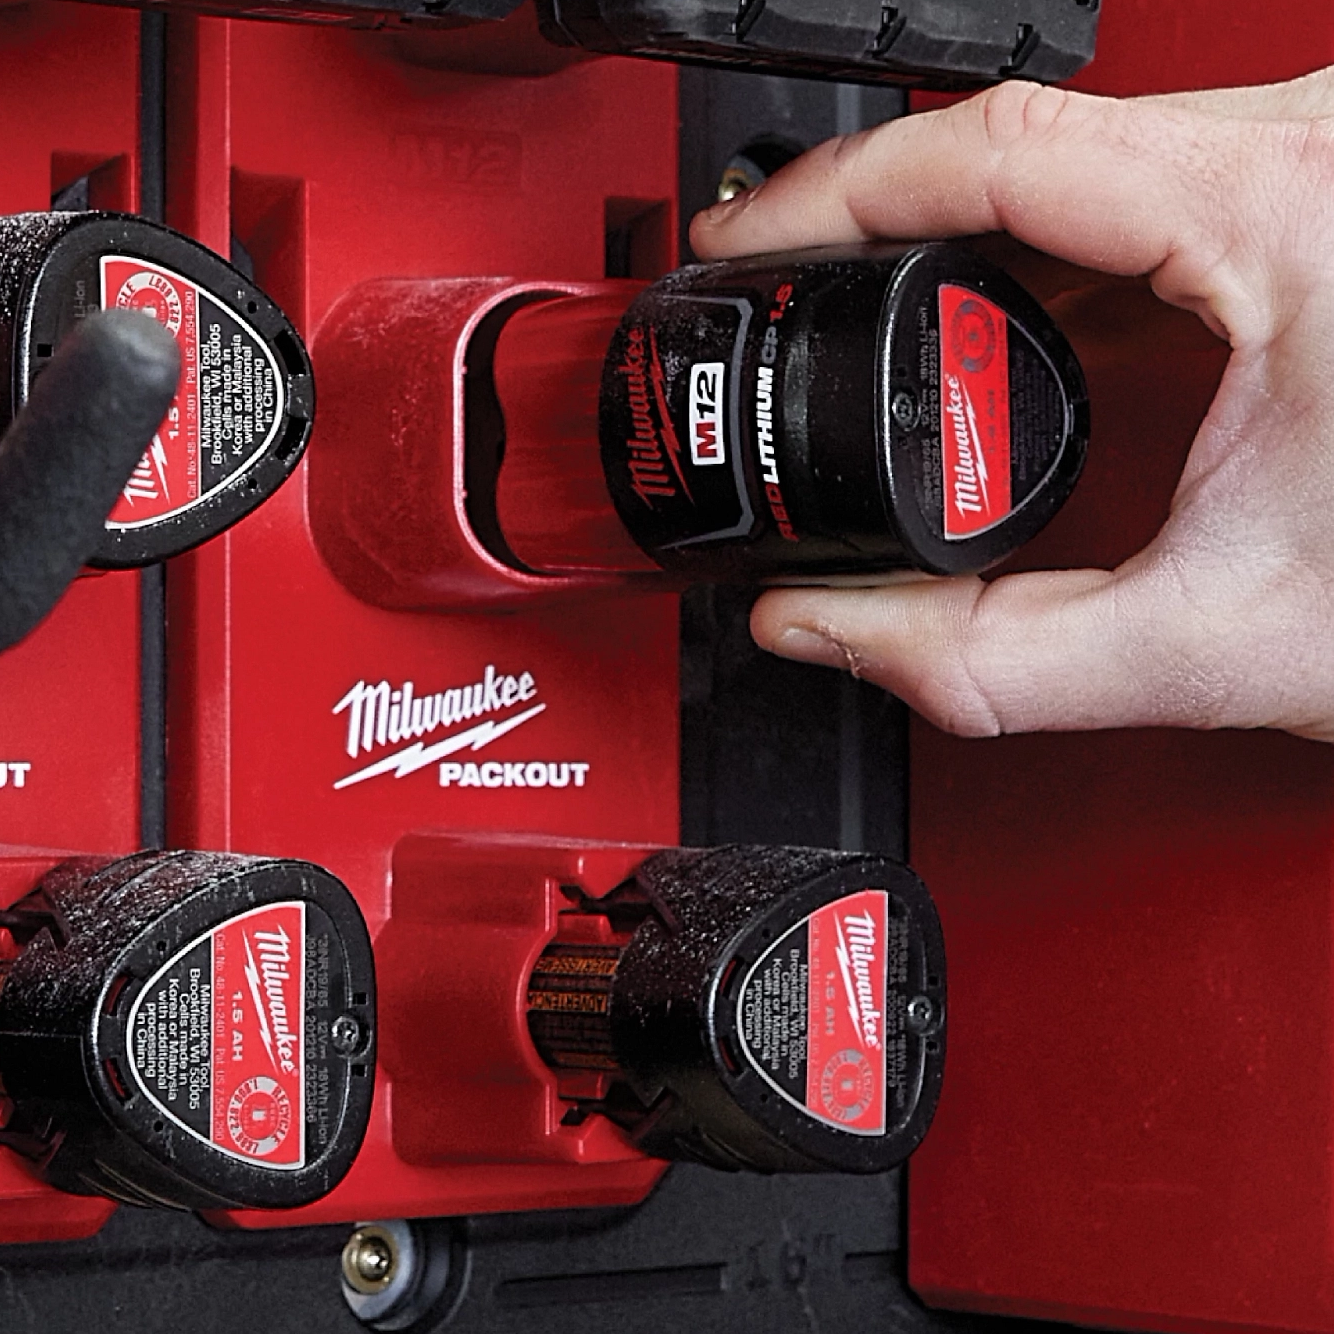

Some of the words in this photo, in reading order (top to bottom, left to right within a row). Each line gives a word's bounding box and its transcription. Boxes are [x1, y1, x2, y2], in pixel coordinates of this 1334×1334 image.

[201, 340, 211, 369] Tool,
[211, 324, 221, 365] 53005
[222, 348, 232, 359] in
[232, 334, 242, 392] Malaysia
[211, 369, 221, 387] WI
[222, 364, 232, 402] made
[243, 346, 252, 411] additional
[253, 358, 264, 431] processing
[263, 368, 273, 406] China
[201, 376, 211, 447] Milwaukee
[232, 397, 242, 410] or
[263, 410, 273, 422] in
[618, 326, 675, 509] Milwaukee
[695, 370, 717, 457] M12
[168, 407, 178, 440] 1.5
[211, 392, 221, 463] Brookfield,
[222, 407, 232, 440] Cells
[232, 414, 242, 454] Korea
[243, 415, 252, 442] with
[756, 366, 798, 541] REDLITHIUM
[946, 375, 981, 518] Milwaukee
[332, 665, 537, 758] Milwaukee
[439, 762, 590, 787] PACKOUT
[844, 909, 879, 1046] Milwaukee
[137, 1012, 146, 1023] in
[158, 990, 167, 1017] with
[168, 978, 177, 1018] Korea
[179, 993, 188, 1026] Cells
[189, 968, 199, 1039] Brookfield,
[232, 990, 242, 1023] 1.5
[253, 923, 296, 1074] Milwaukee
[168, 1022, 177, 1035] or
[199, 984, 209, 1055] Milwaukee
[137, 1029, 146, 1068] China
[146, 1002, 156, 1077] processing
[158, 1022, 167, 1088] additional
[179, 1037, 188, 1069] made
[189, 1045, 199, 1062] WI
[232, 1030, 242, 1060] AH
[168, 1040, 177, 1100] Malaysia
[179, 1073, 188, 1085] in
[189, 1066, 199, 1108] 53005
[199, 1062, 209, 1087] Tool,
[271, 1088, 289, 1143] RECYCLE
